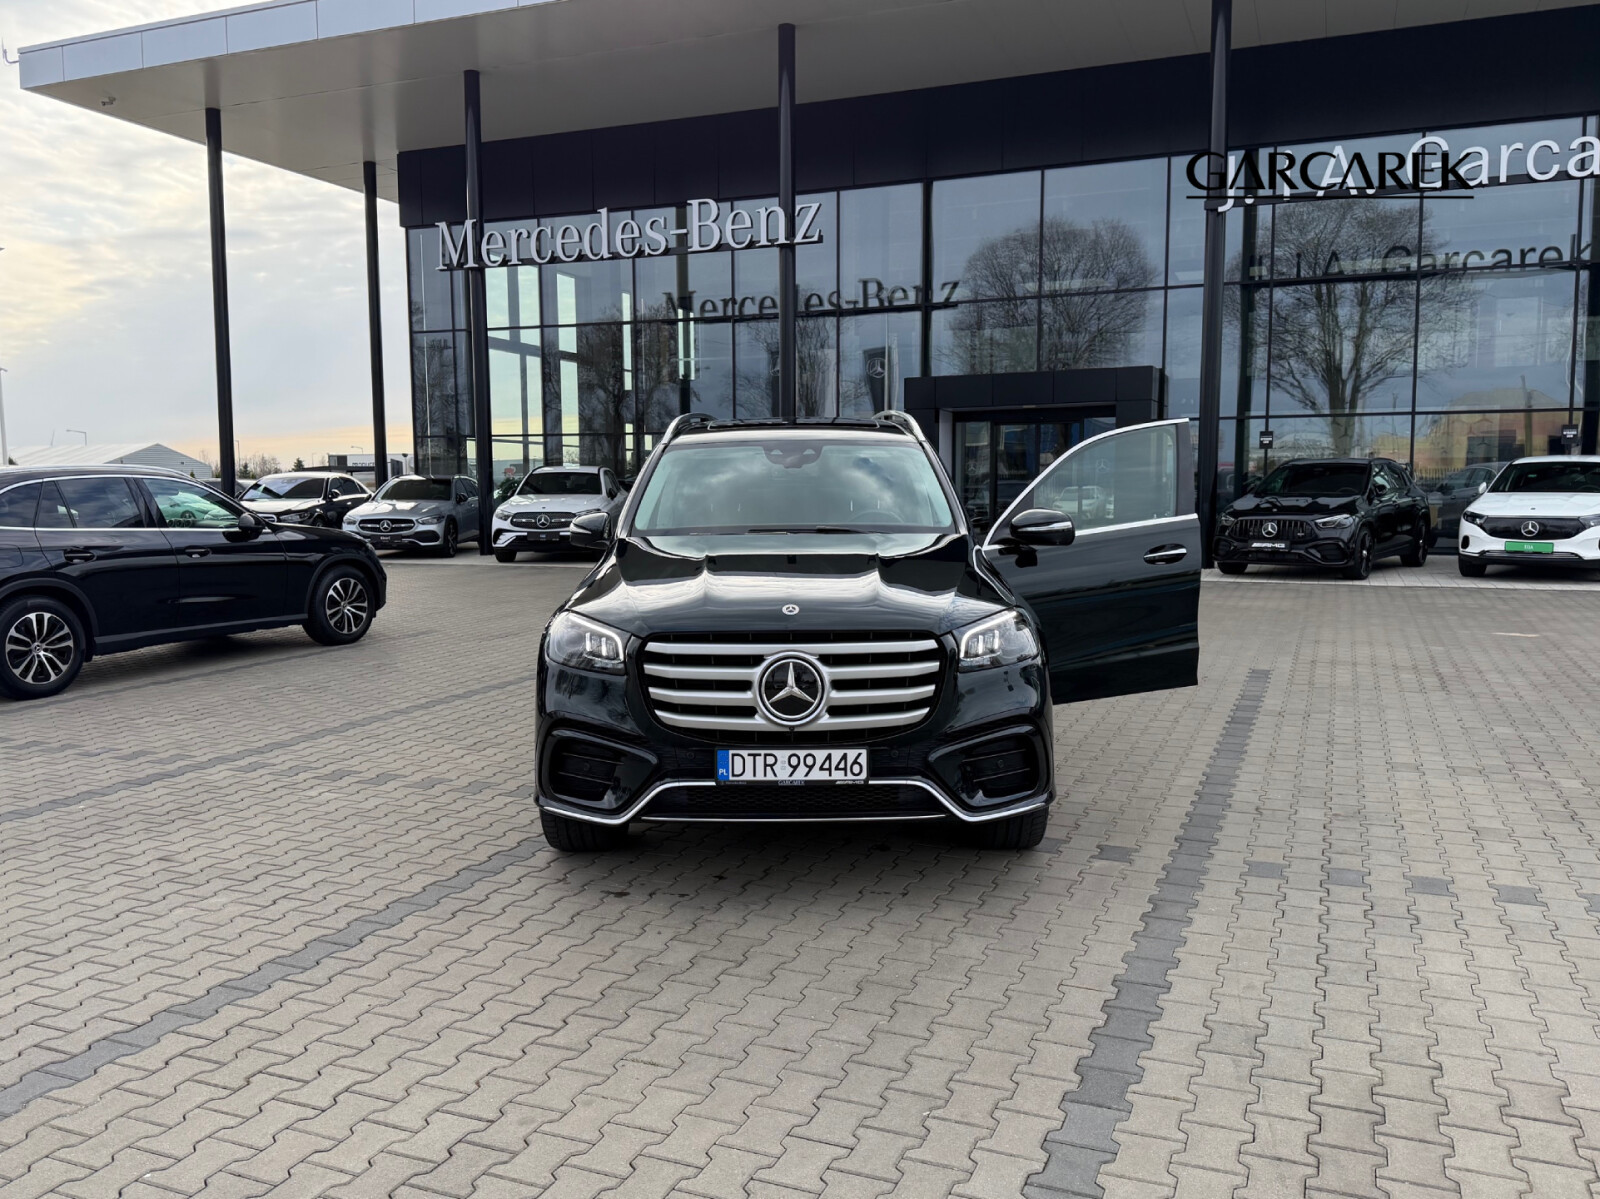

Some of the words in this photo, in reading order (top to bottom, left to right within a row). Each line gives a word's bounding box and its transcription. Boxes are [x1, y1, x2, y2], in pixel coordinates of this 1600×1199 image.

[434, 198, 822, 270] Mercedes-Benz
[731, 753, 778, 777] DTR
[787, 753, 863, 777] 99446
